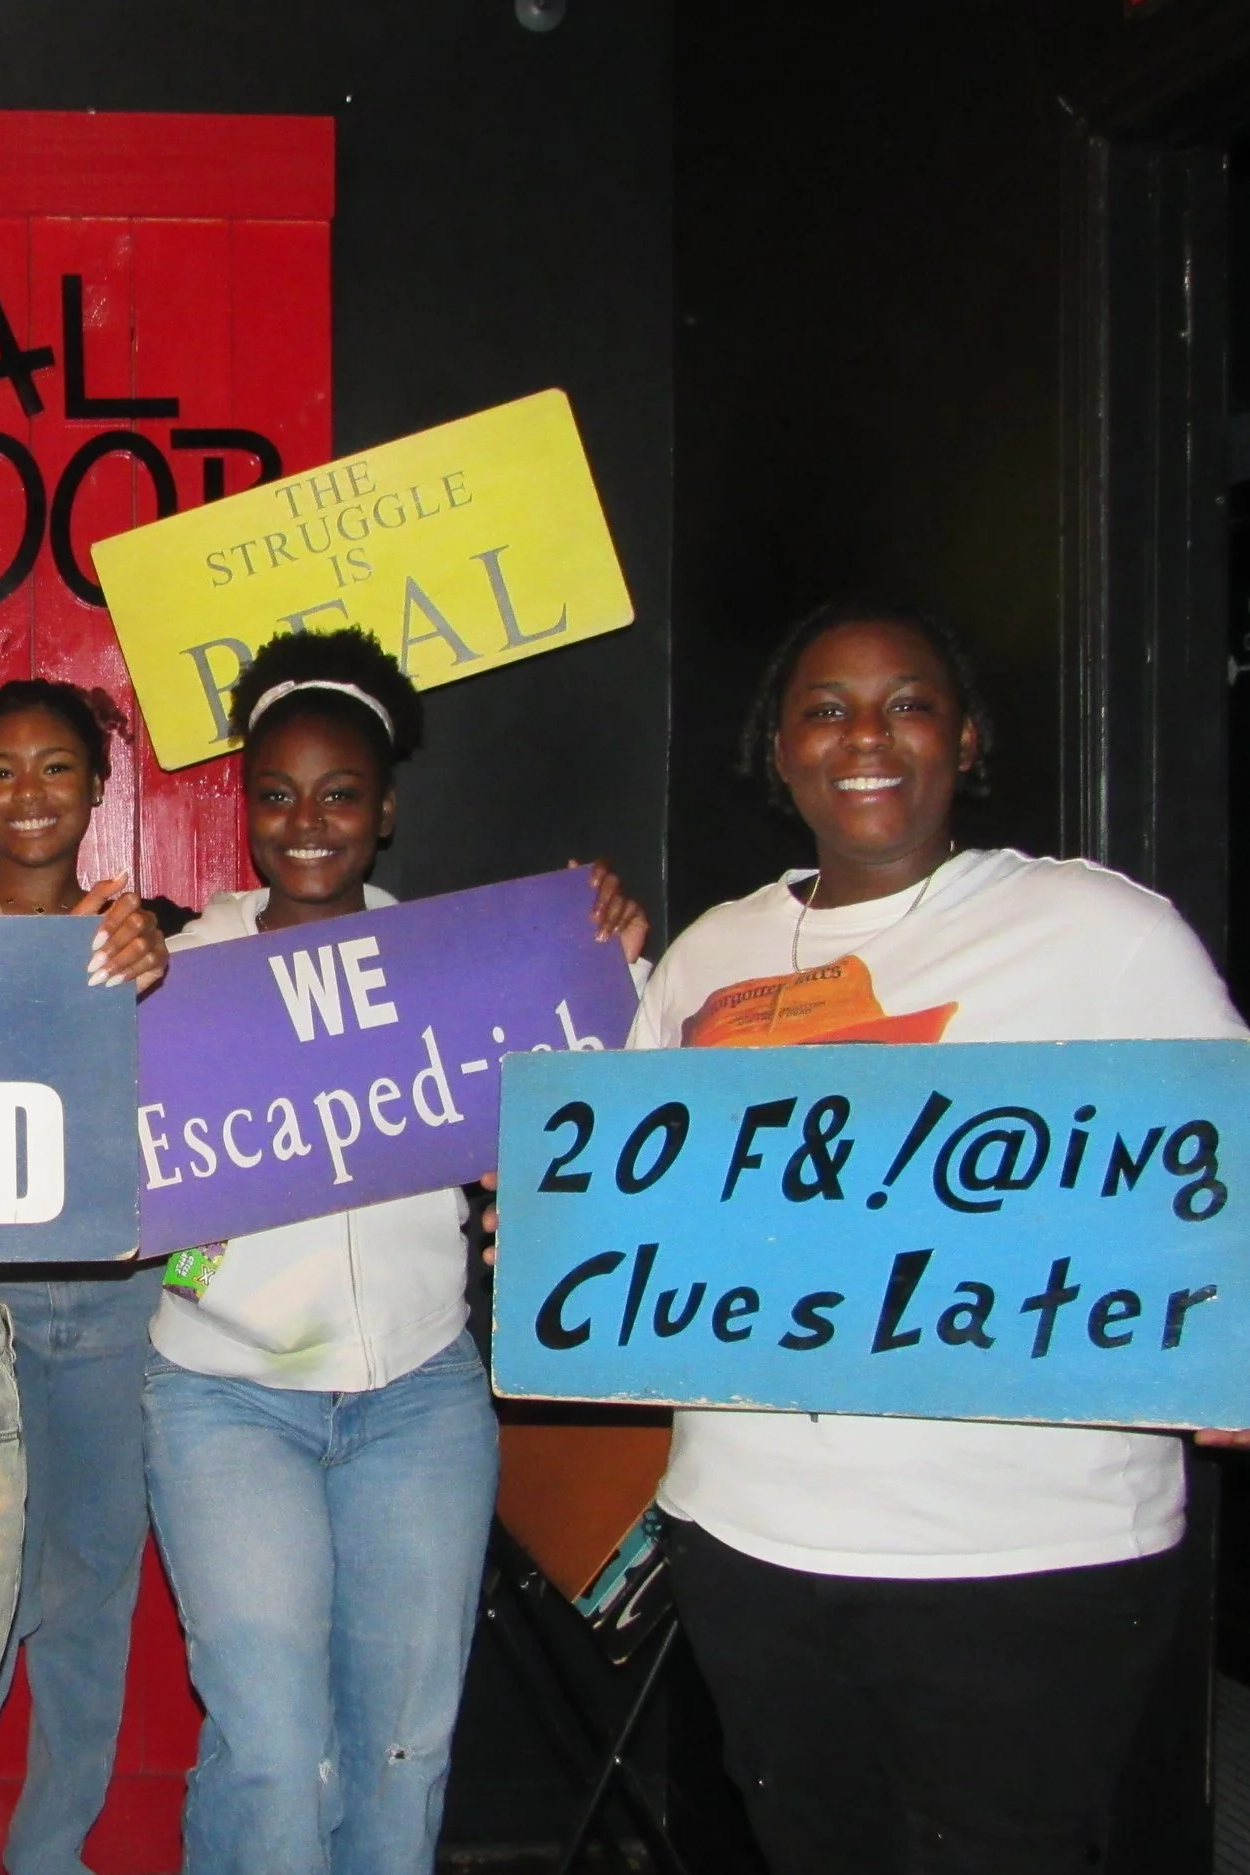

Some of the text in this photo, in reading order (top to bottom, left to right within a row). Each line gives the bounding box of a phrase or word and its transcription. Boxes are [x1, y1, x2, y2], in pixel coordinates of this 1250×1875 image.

[205, 471, 474, 588] STRUGGLE
[275, 460, 377, 519] THE
[329, 548, 374, 588] IS
[268, 936, 398, 1043] WE
[537, 1101, 691, 1195] 20
[535, 1243, 1218, 1359] Clues Later
